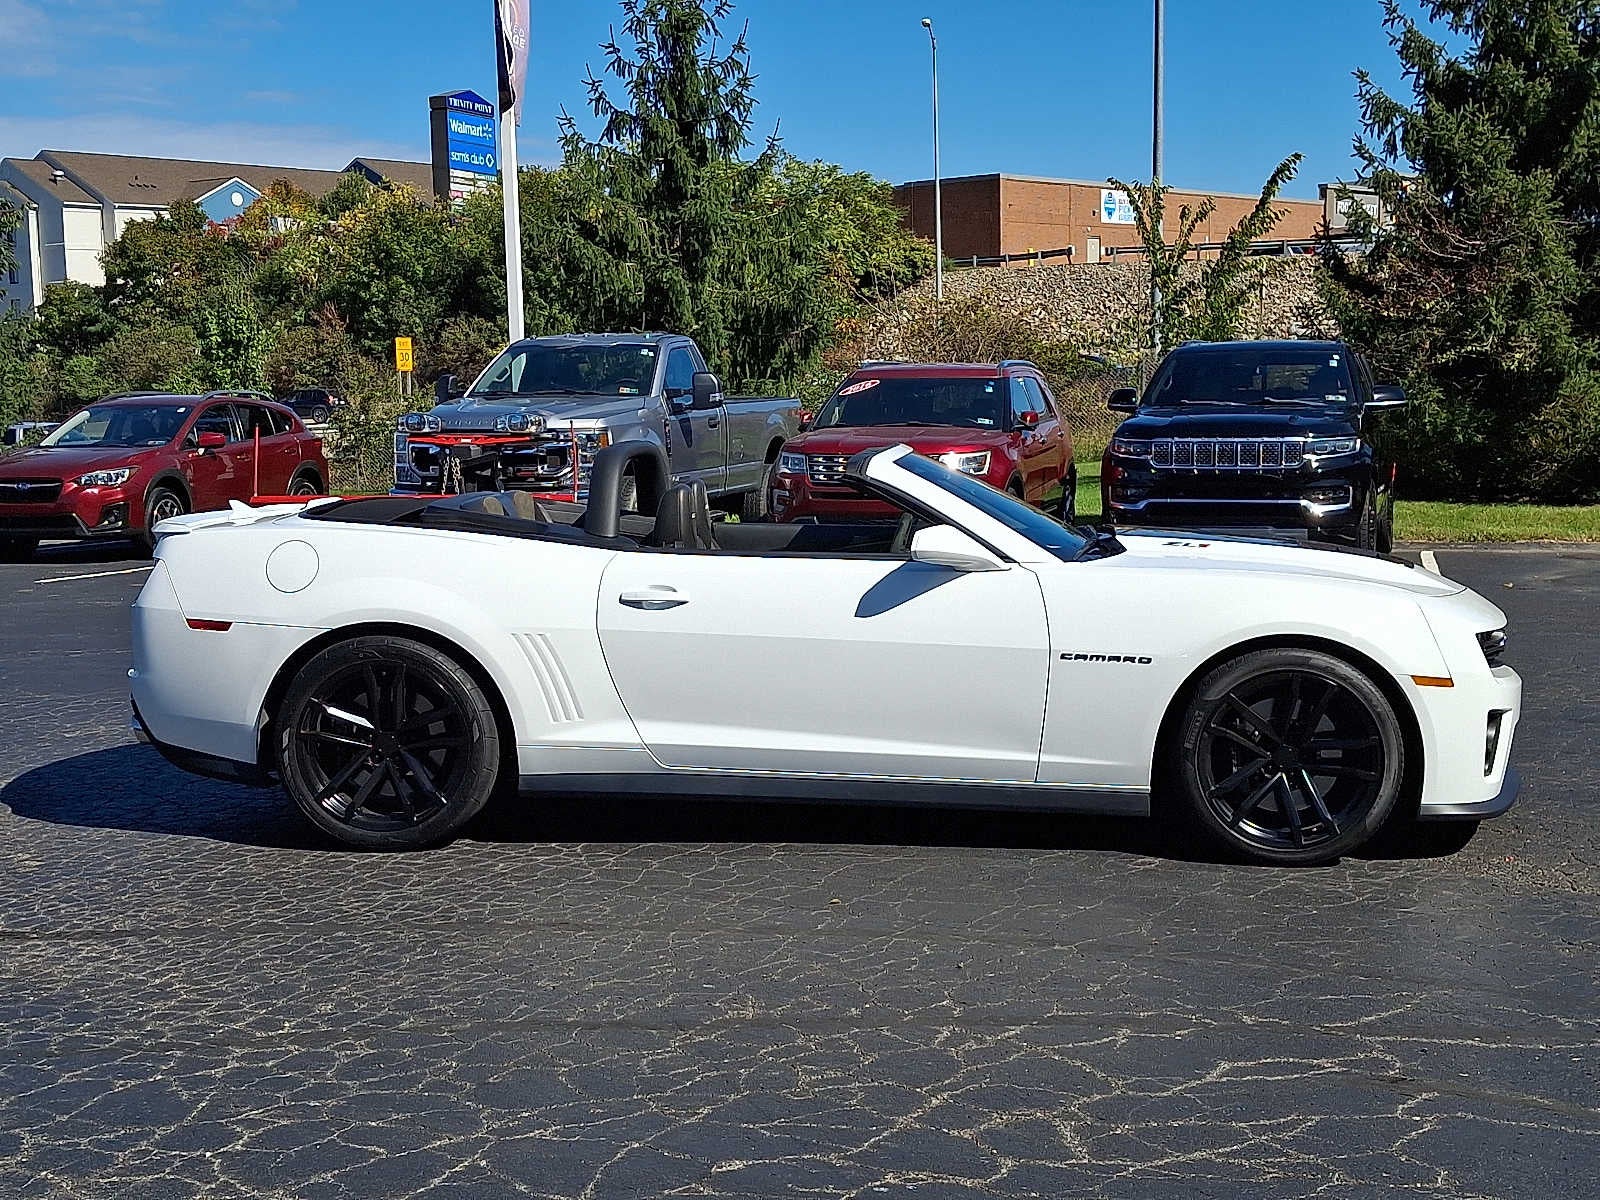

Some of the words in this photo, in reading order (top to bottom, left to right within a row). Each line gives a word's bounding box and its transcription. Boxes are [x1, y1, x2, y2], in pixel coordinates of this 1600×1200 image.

[449, 97, 473, 110] TRINITY
[474, 102, 493, 114] POINT
[449, 119, 483, 137] Walmart
[470, 152, 485, 166] club
[399, 352, 410, 362] 30
[1059, 652, 1153, 665] CAMARO
